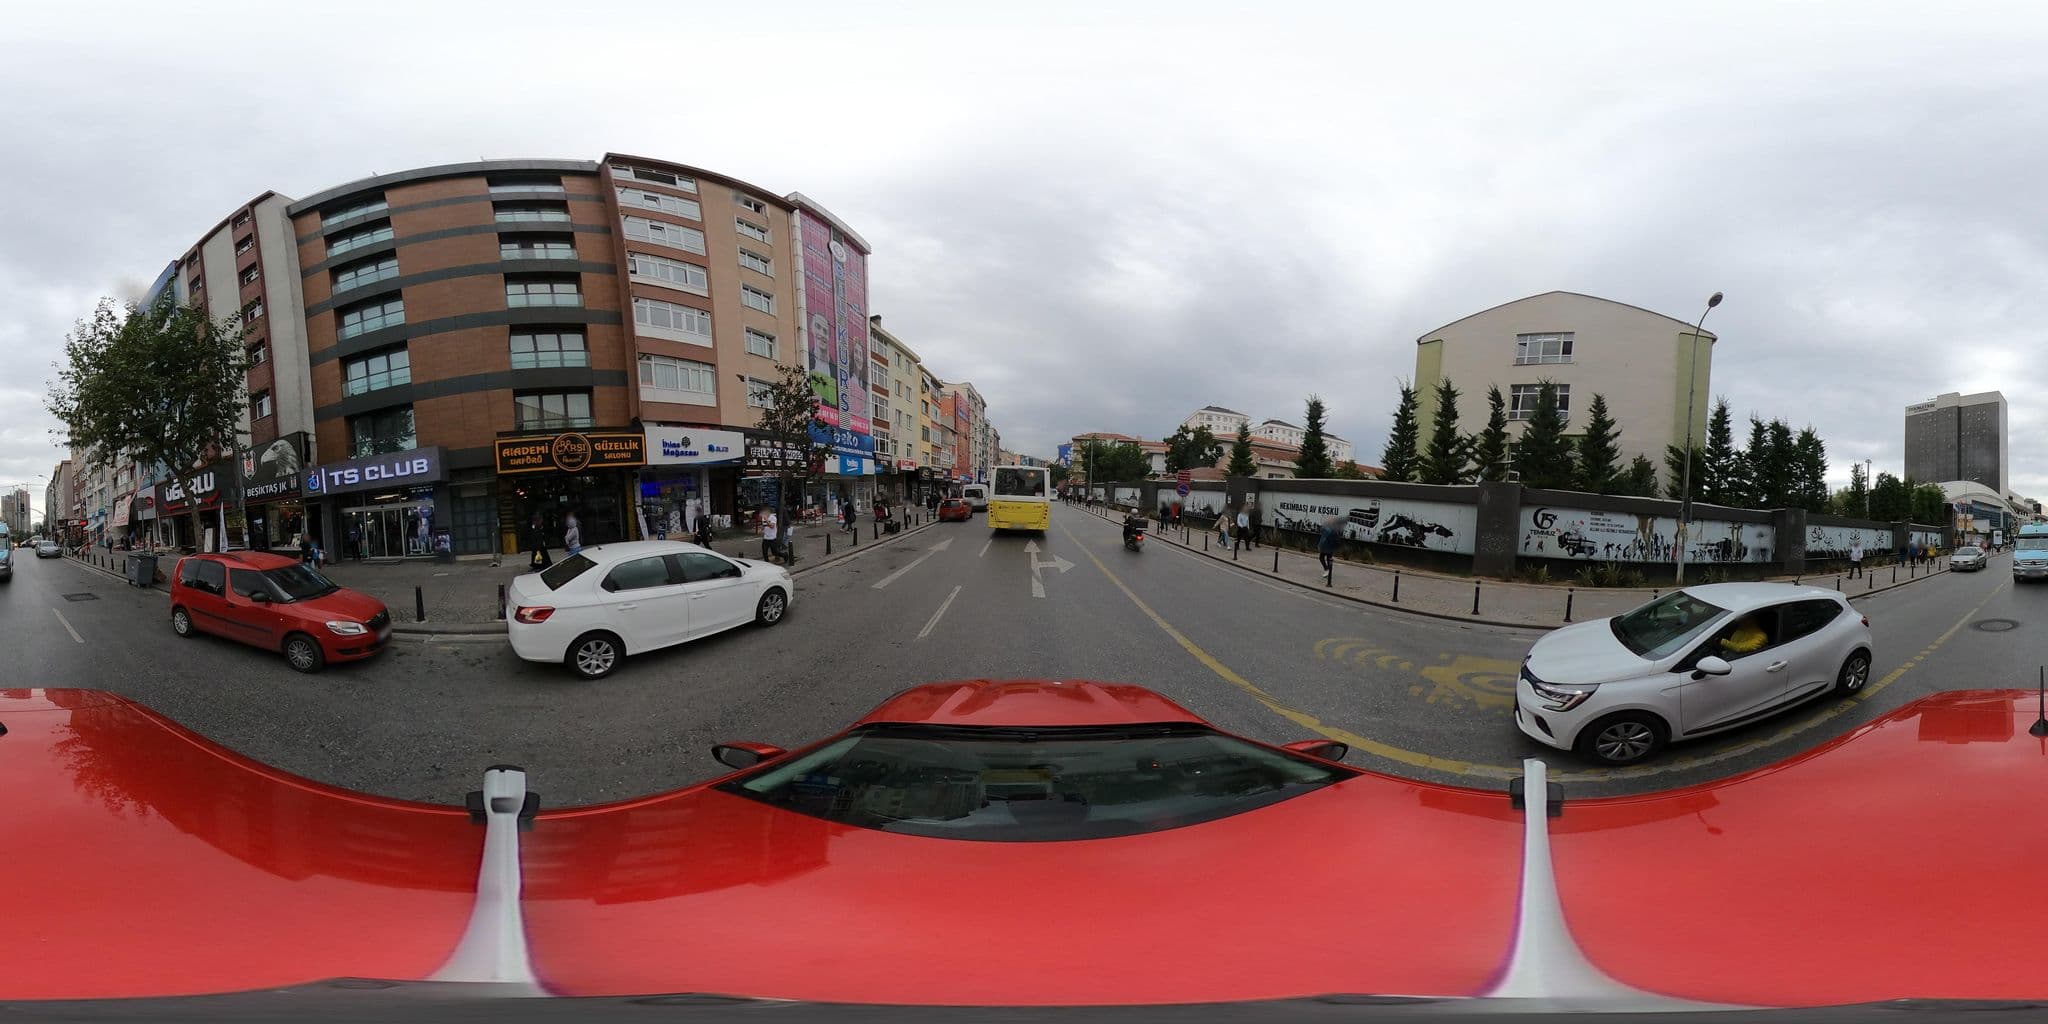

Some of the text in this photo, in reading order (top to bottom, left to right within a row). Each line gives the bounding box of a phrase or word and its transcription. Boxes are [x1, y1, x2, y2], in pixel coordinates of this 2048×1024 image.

[594, 440, 639, 451] GÜZELLİK
[329, 458, 429, 486] TS CLUB
[246, 481, 287, 498] BEŞİKTAŞ JK
[1309, 505, 1316, 513] AV
